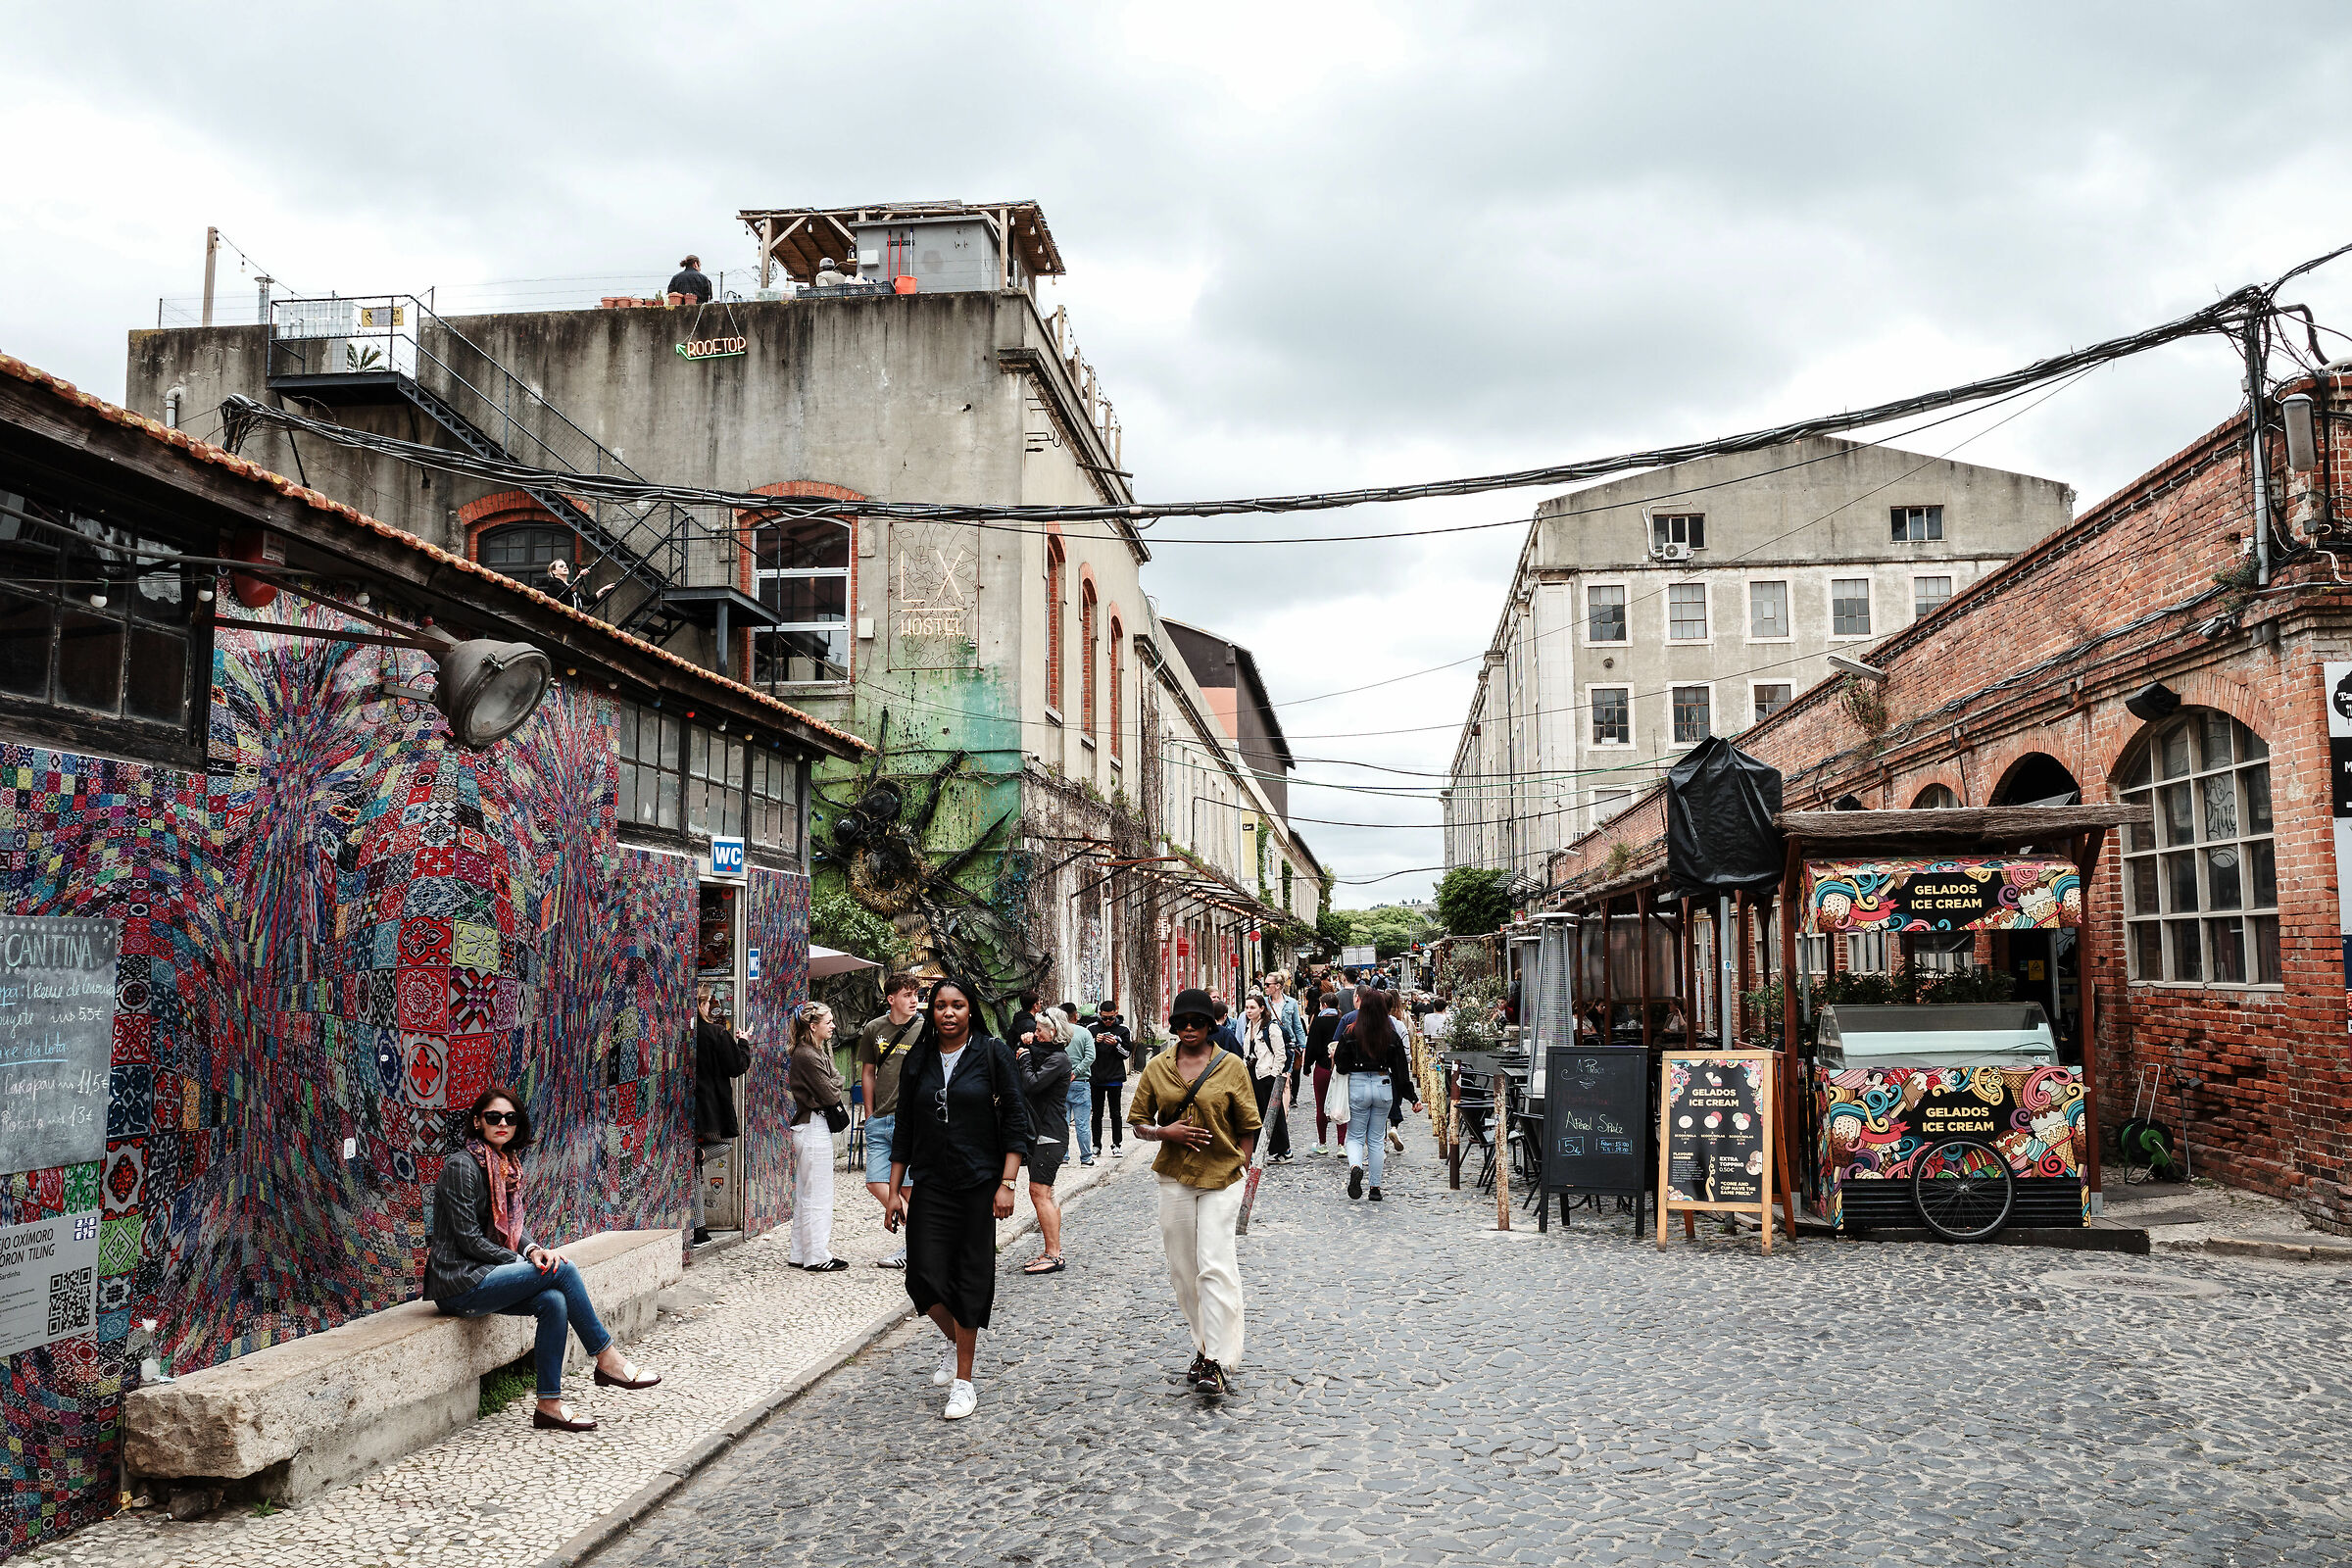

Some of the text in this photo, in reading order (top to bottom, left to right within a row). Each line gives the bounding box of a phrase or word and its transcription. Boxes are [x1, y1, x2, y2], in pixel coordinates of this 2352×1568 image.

[687, 336, 746, 357] ROOFTOP
[901, 550, 964, 603] LX
[901, 617, 965, 636] HOSTEL
[714, 846, 742, 865] WC
[1914, 884, 1978, 896] GELADOS
[1911, 899, 1983, 909] ICE CREAM
[5, 933, 93, 968] CANTINA
[750, 956, 759, 971] WC
[24, 1038, 40, 1057] da
[1705, 1099, 1740, 1107] CREAM
[1926, 1106, 1989, 1117] GELADOS
[1922, 1121, 1994, 1132] ICE CREAM
[0, 1237, 11, 1253] JO
[13, 1228, 54, 1249] OXÍMORO
[28, 1243, 55, 1261] TILING
